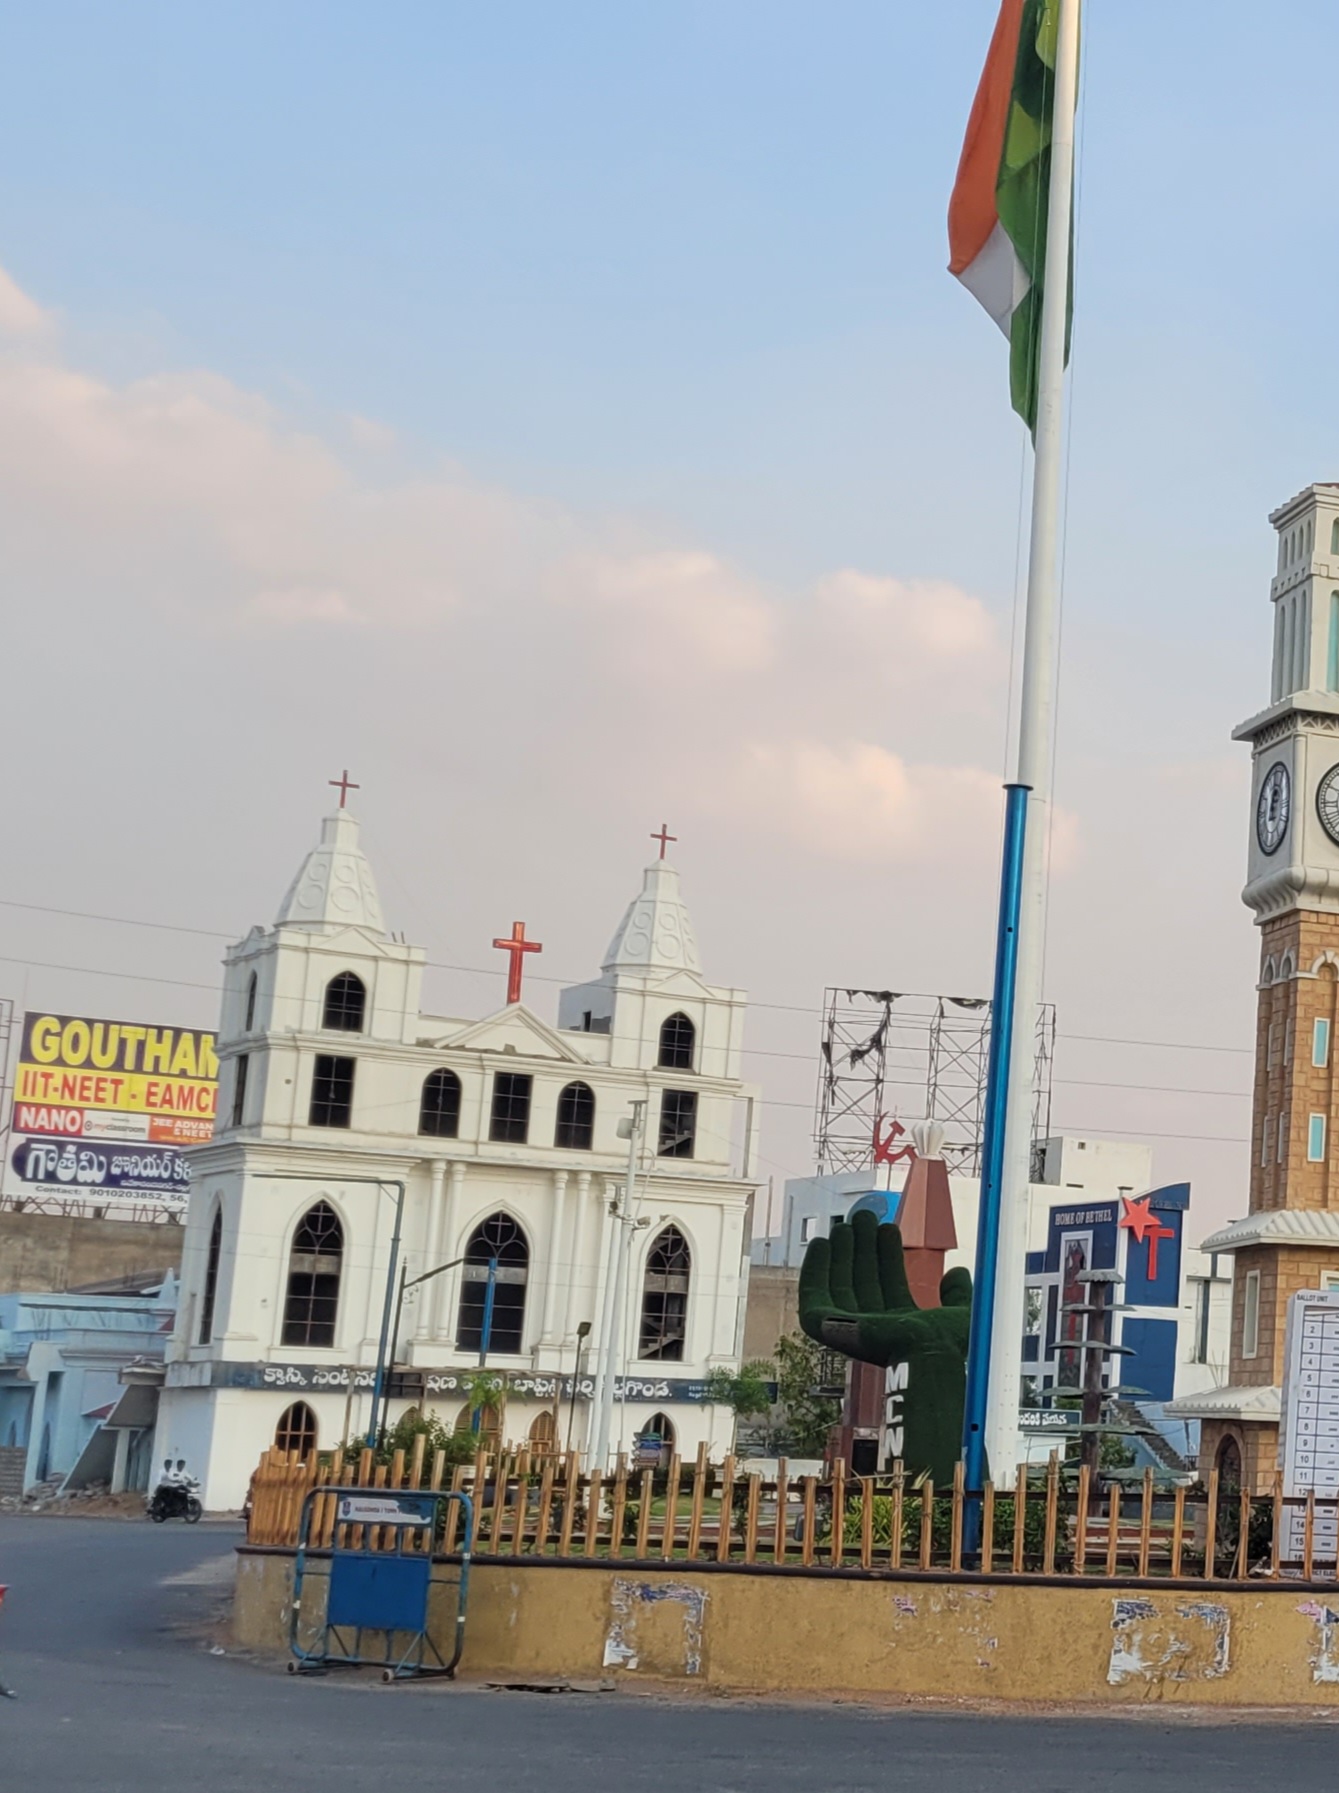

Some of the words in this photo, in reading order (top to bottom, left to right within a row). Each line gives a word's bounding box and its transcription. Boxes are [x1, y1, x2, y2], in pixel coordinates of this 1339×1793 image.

[20, 1106, 81, 1133] NANO
[35, 1185, 82, 1195] Contact:
[1055, 1212, 1075, 1225] HOME
[1075, 1211, 1085, 1224] OF
[1085, 1209, 1112, 1224] BETHEL
[1297, 1294, 1316, 1302] BALLOT
[1317, 1295, 1328, 1303] UNIT
[1300, 1455, 1310, 1463] 10
[1299, 1471, 1308, 1480] 11
[1296, 1521, 1305, 1529] 14
[1295, 1537, 1304, 1546] 15
